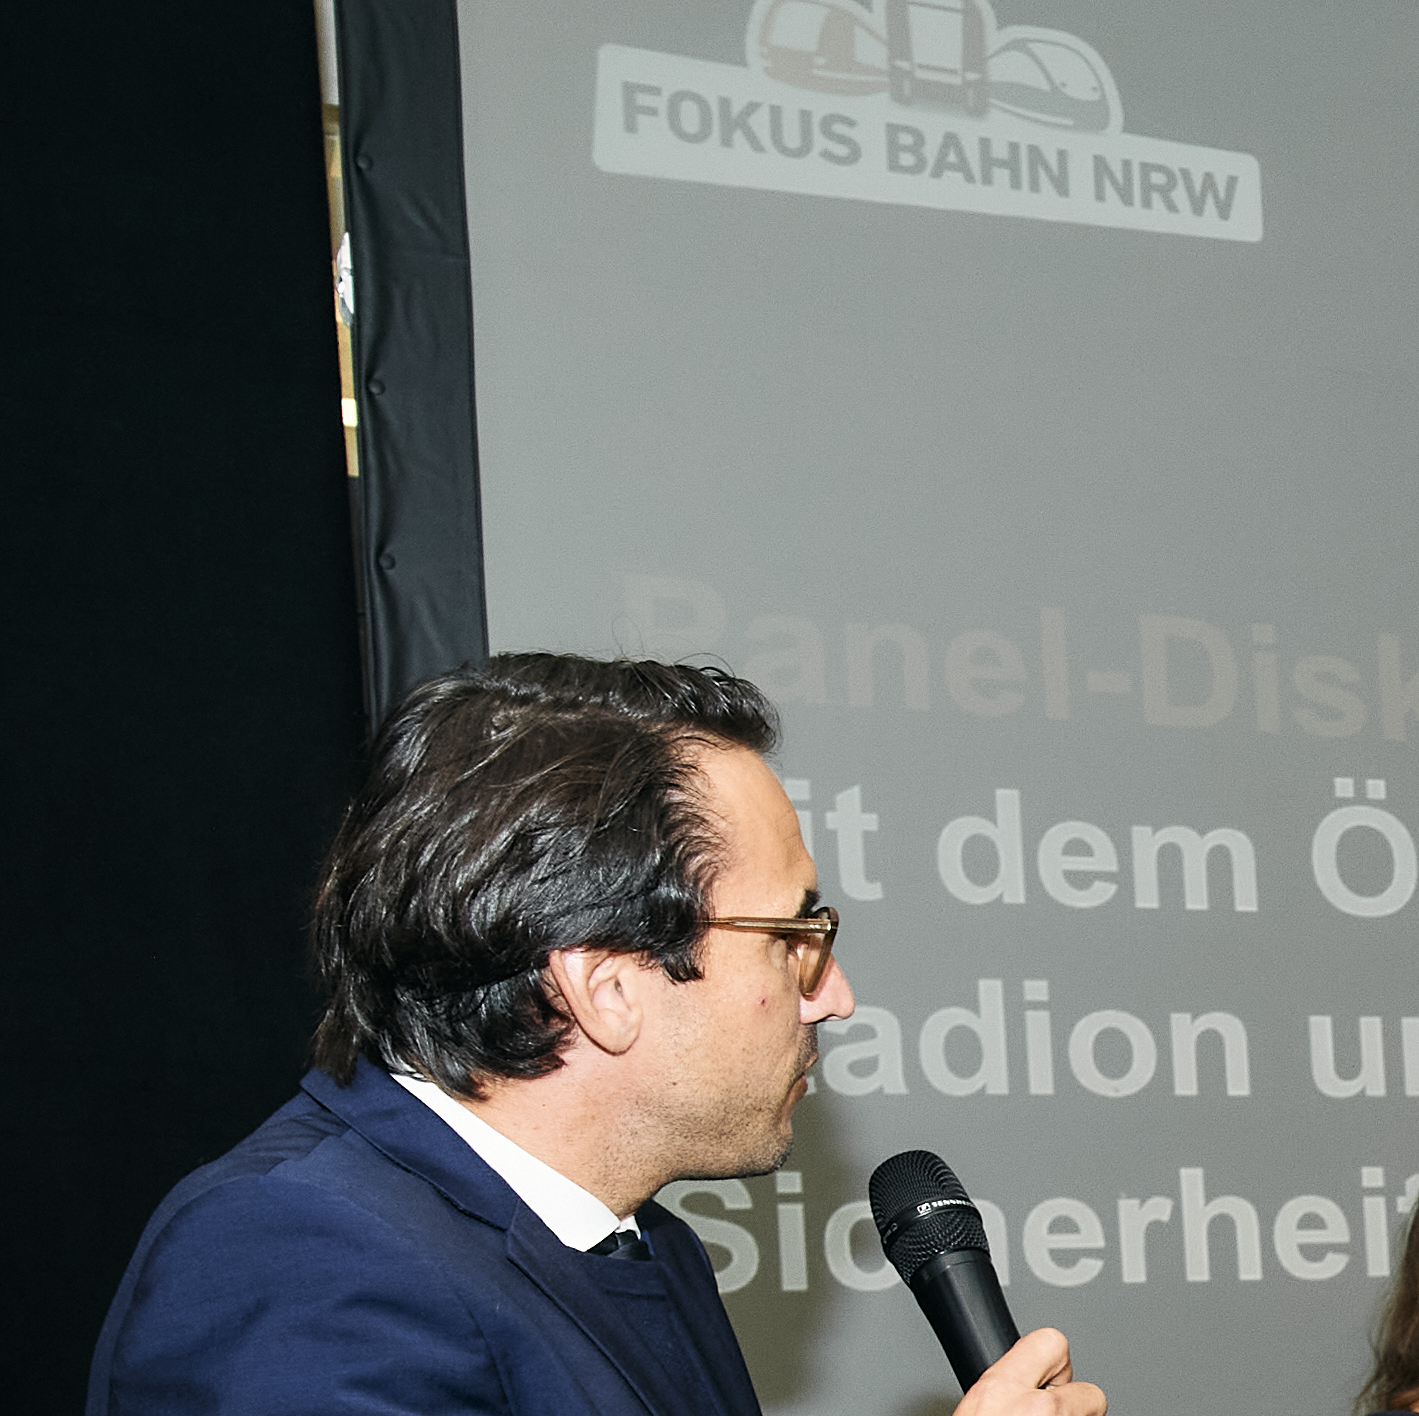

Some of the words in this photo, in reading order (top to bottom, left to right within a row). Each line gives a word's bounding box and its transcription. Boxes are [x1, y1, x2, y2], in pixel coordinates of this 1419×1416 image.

[620, 80, 863, 168] FOKUS
[884, 121, 1070, 199] BAHN
[1091, 153, 1240, 222] NRW
[936, 788, 1259, 912] dem
[806, 977, 1251, 1099] adion
